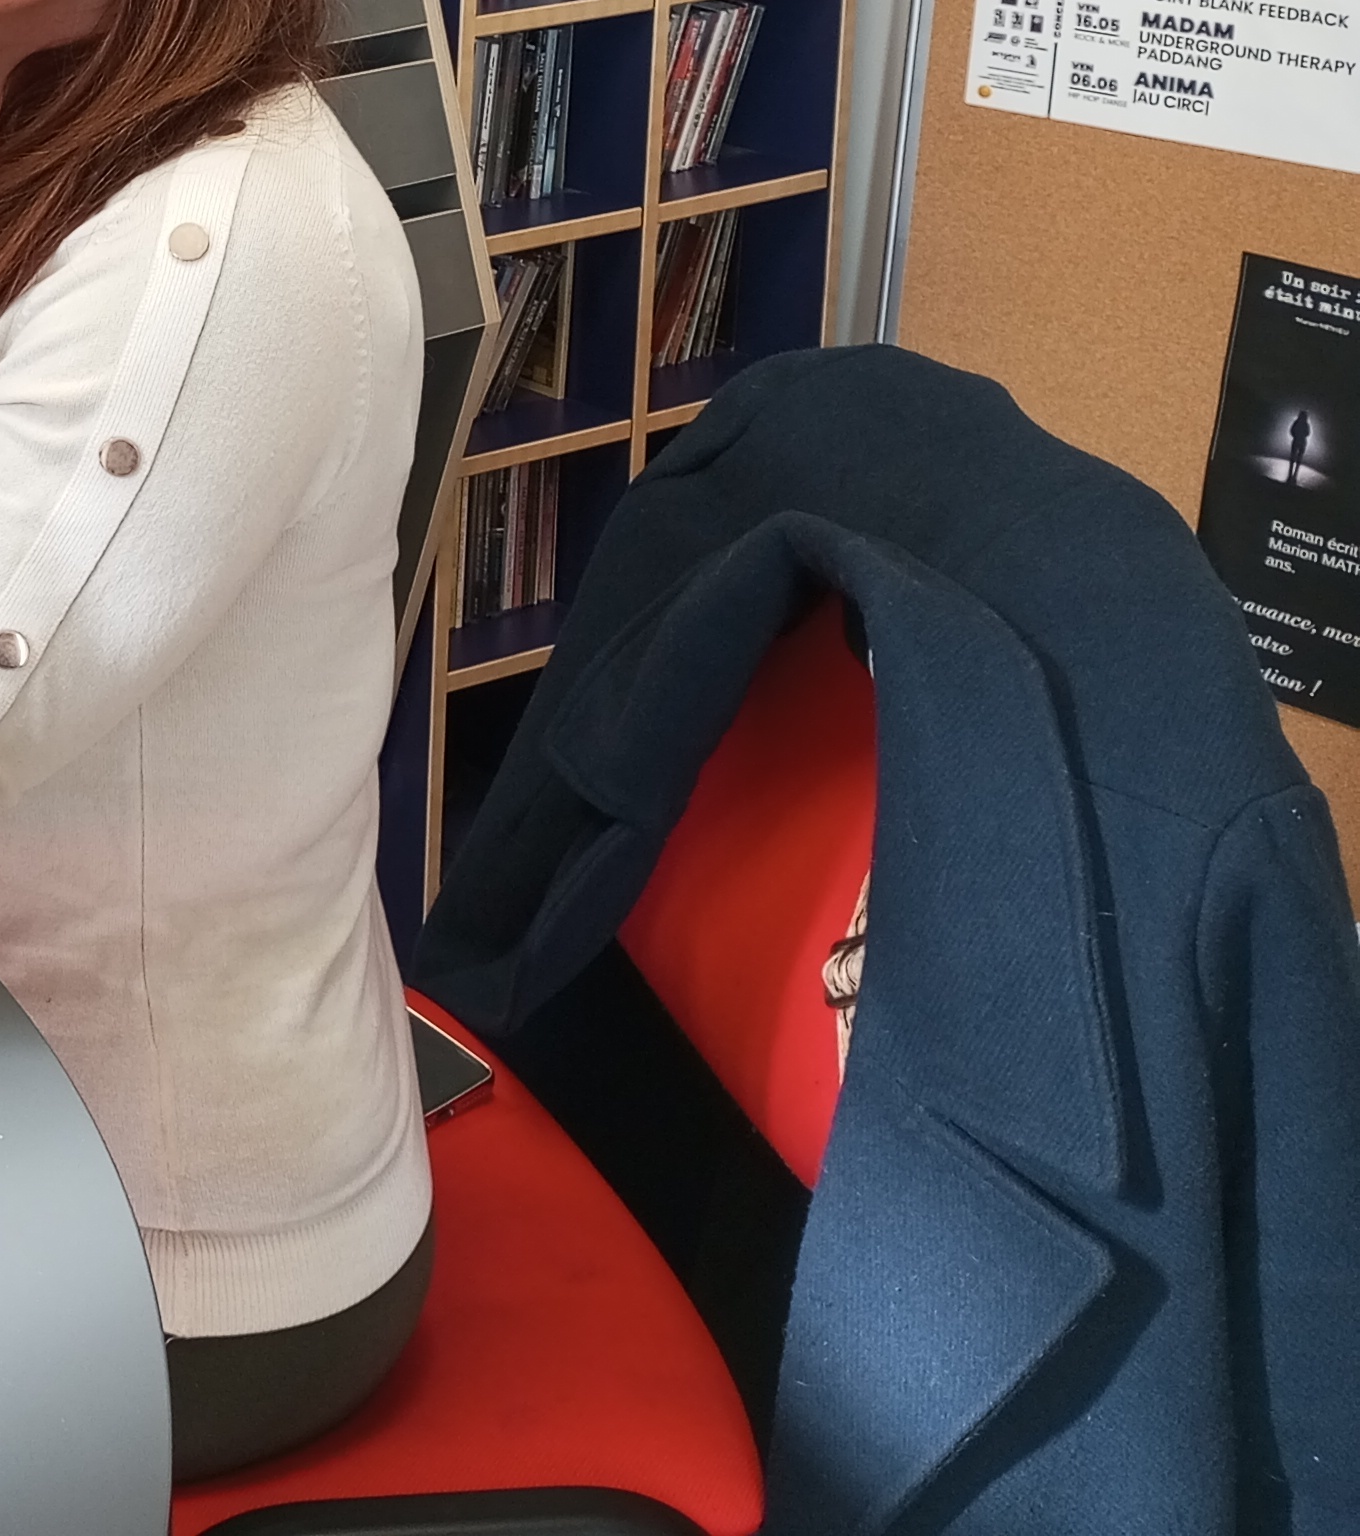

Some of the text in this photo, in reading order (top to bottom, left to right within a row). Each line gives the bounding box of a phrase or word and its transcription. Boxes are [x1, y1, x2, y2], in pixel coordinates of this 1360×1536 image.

[1076, 14, 1120, 32] 16.05
[1141, 12, 1235, 40] MADAM
[1259, 3, 1349, 29] FEEDBACK
[1137, 46, 1223, 71] PADDANG
[1139, 30, 1356, 76] UNDERGROUND THERAPY
[1071, 73, 1118, 92] 06.06
[1134, 71, 1214, 99] ANIMA
[1264, 285, 1314, 309] était
[1282, 271, 1304, 289] Un
[1311, 281, 1351, 300] soir
[1268, 537, 1318, 563] Marion
[1271, 519, 1358, 558] Roman écrit
[1264, 555, 1296, 574] ans.
[1243, 599, 1317, 635] avance,
[1248, 633, 1294, 656] otre
[1309, 679, 1323, 698] !
